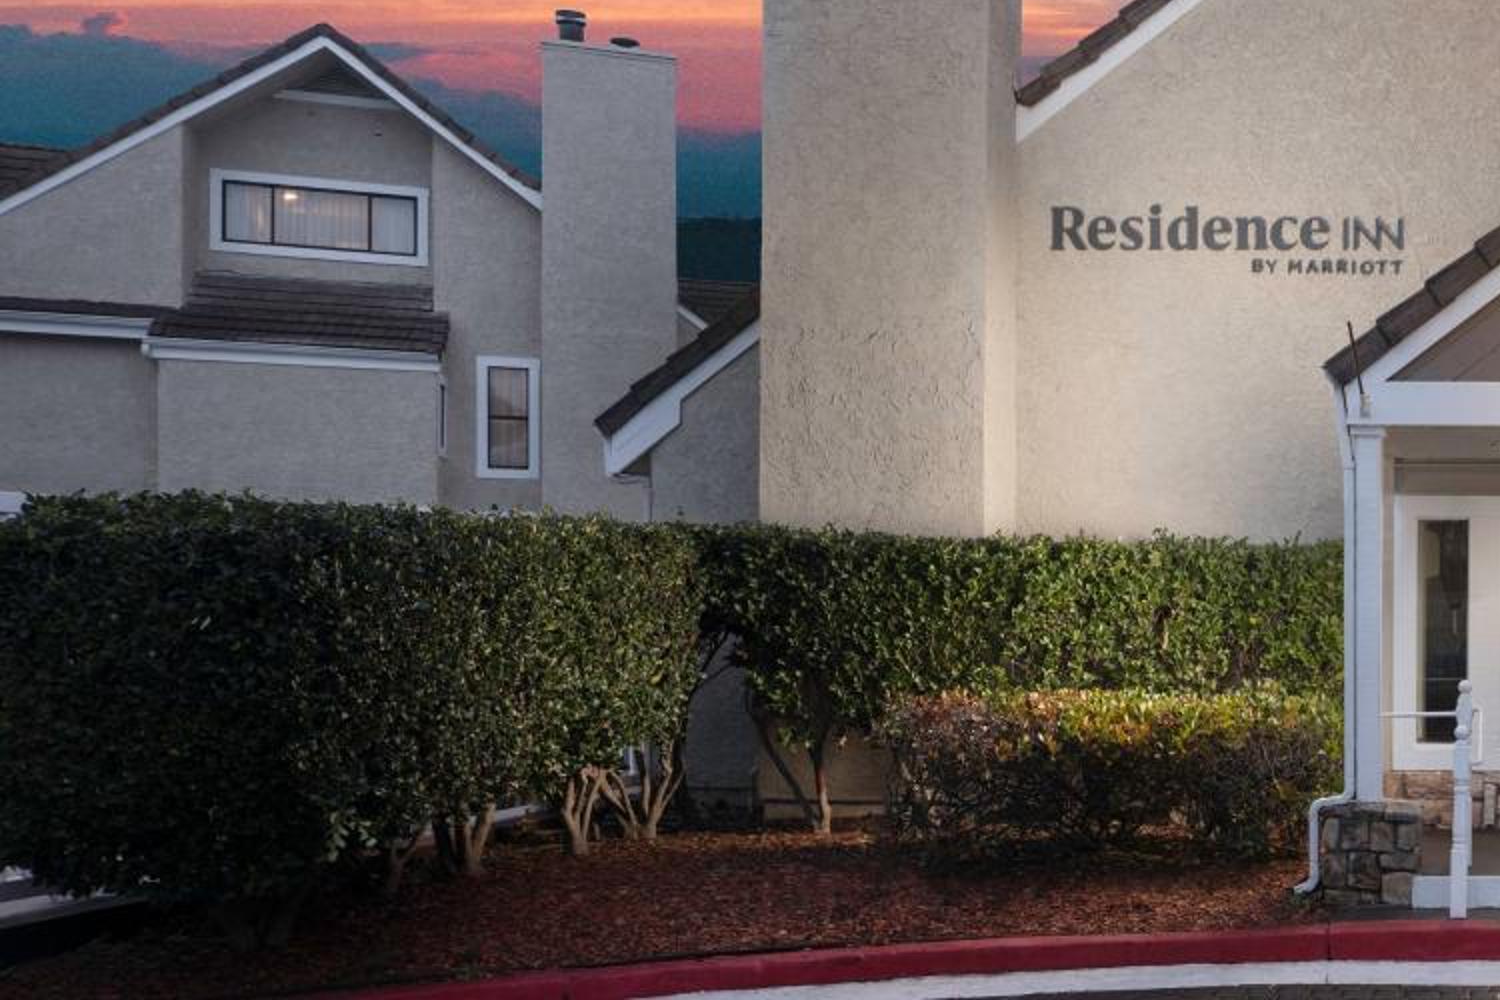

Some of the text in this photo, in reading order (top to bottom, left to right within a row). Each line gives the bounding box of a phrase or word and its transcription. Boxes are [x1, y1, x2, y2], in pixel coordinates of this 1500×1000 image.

[1049, 204, 1405, 251] Residence INN
[1251, 258, 1404, 276] BY MARRIOTT
